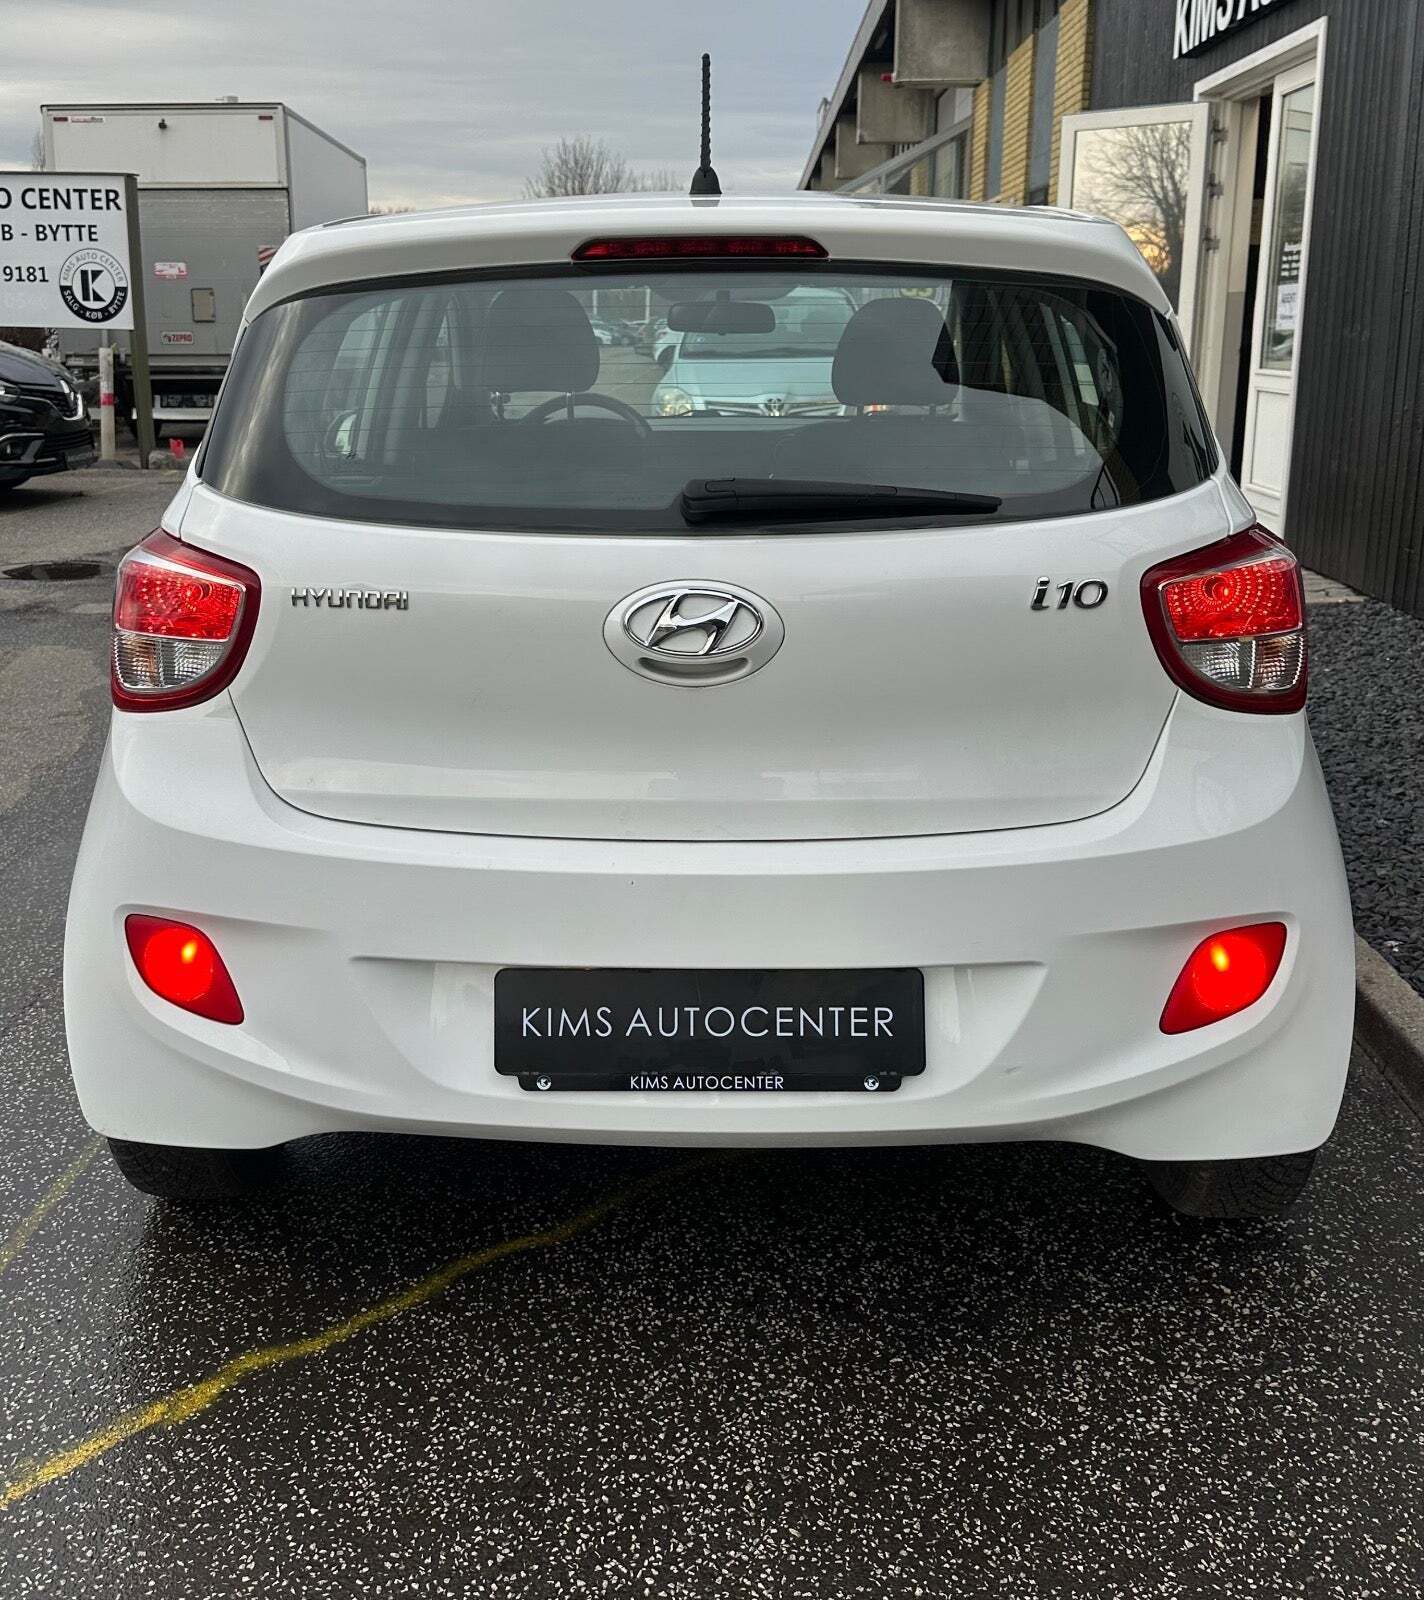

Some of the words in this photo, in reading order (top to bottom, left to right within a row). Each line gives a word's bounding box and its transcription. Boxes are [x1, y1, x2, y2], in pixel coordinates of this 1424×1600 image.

[21, 187, 122, 211] CENTER
[35, 223, 98, 242] BYTTE
[3, 265, 49, 282] 9181
[62, 260, 76, 281] KIMS
[75, 252, 98, 262] AUTO
[100, 254, 124, 282] CENTER
[63, 289, 80, 311] SALG
[86, 310, 103, 319] KØB
[108, 290, 125, 314] BYTTE
[290, 587, 409, 610] HYUNDAI
[1031, 576, 1108, 611] i10
[522, 1005, 612, 1037] KIMS
[625, 1005, 895, 1037] AUTOCENTER
[630, 1075, 668, 1089] KIMS
[673, 1075, 785, 1089] AUTOCENTER
